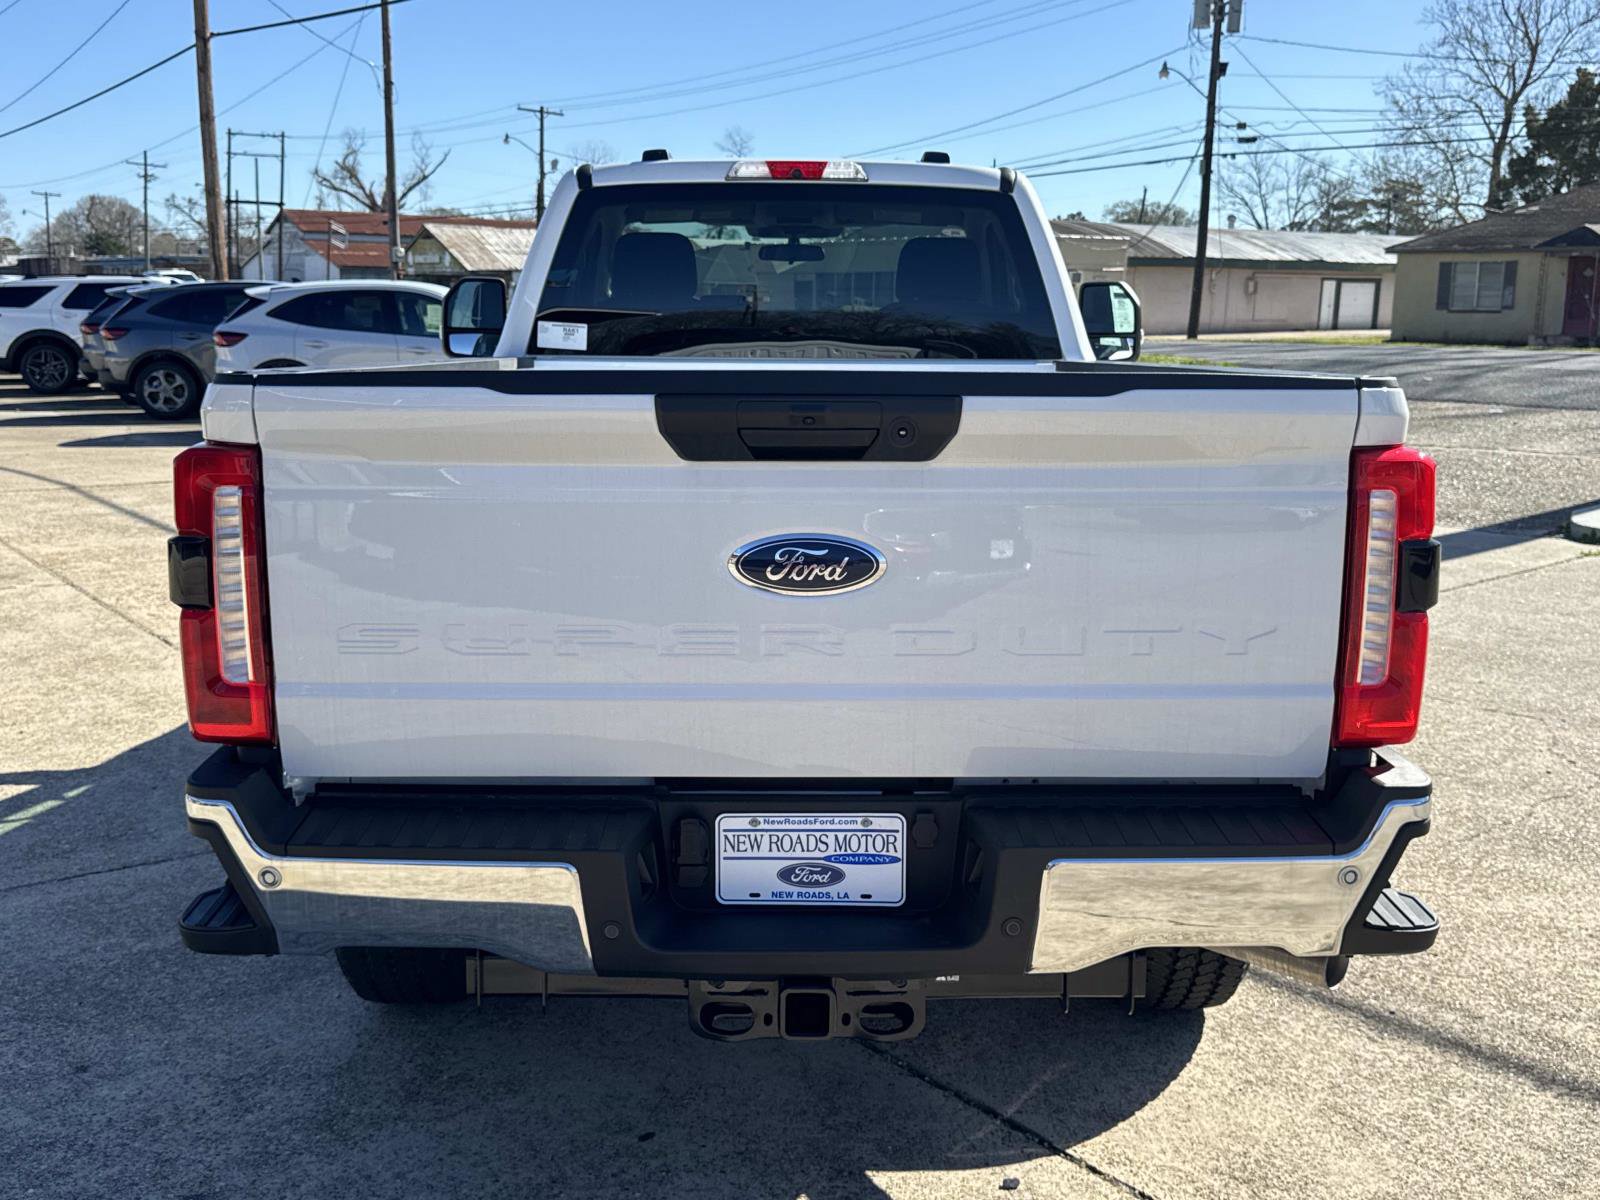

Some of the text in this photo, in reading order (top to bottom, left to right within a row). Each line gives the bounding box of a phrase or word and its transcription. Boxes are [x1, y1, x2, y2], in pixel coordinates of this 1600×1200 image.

[765, 547, 850, 581] Ford
[337, 622, 1278, 657] SUPER DUTY
[763, 818, 858, 826] NewRoadsFord.com
[723, 834, 898, 853] NEW ROADS MOTOR
[791, 866, 832, 883] Ford
[771, 891, 849, 900] NEW ROADS, LA
